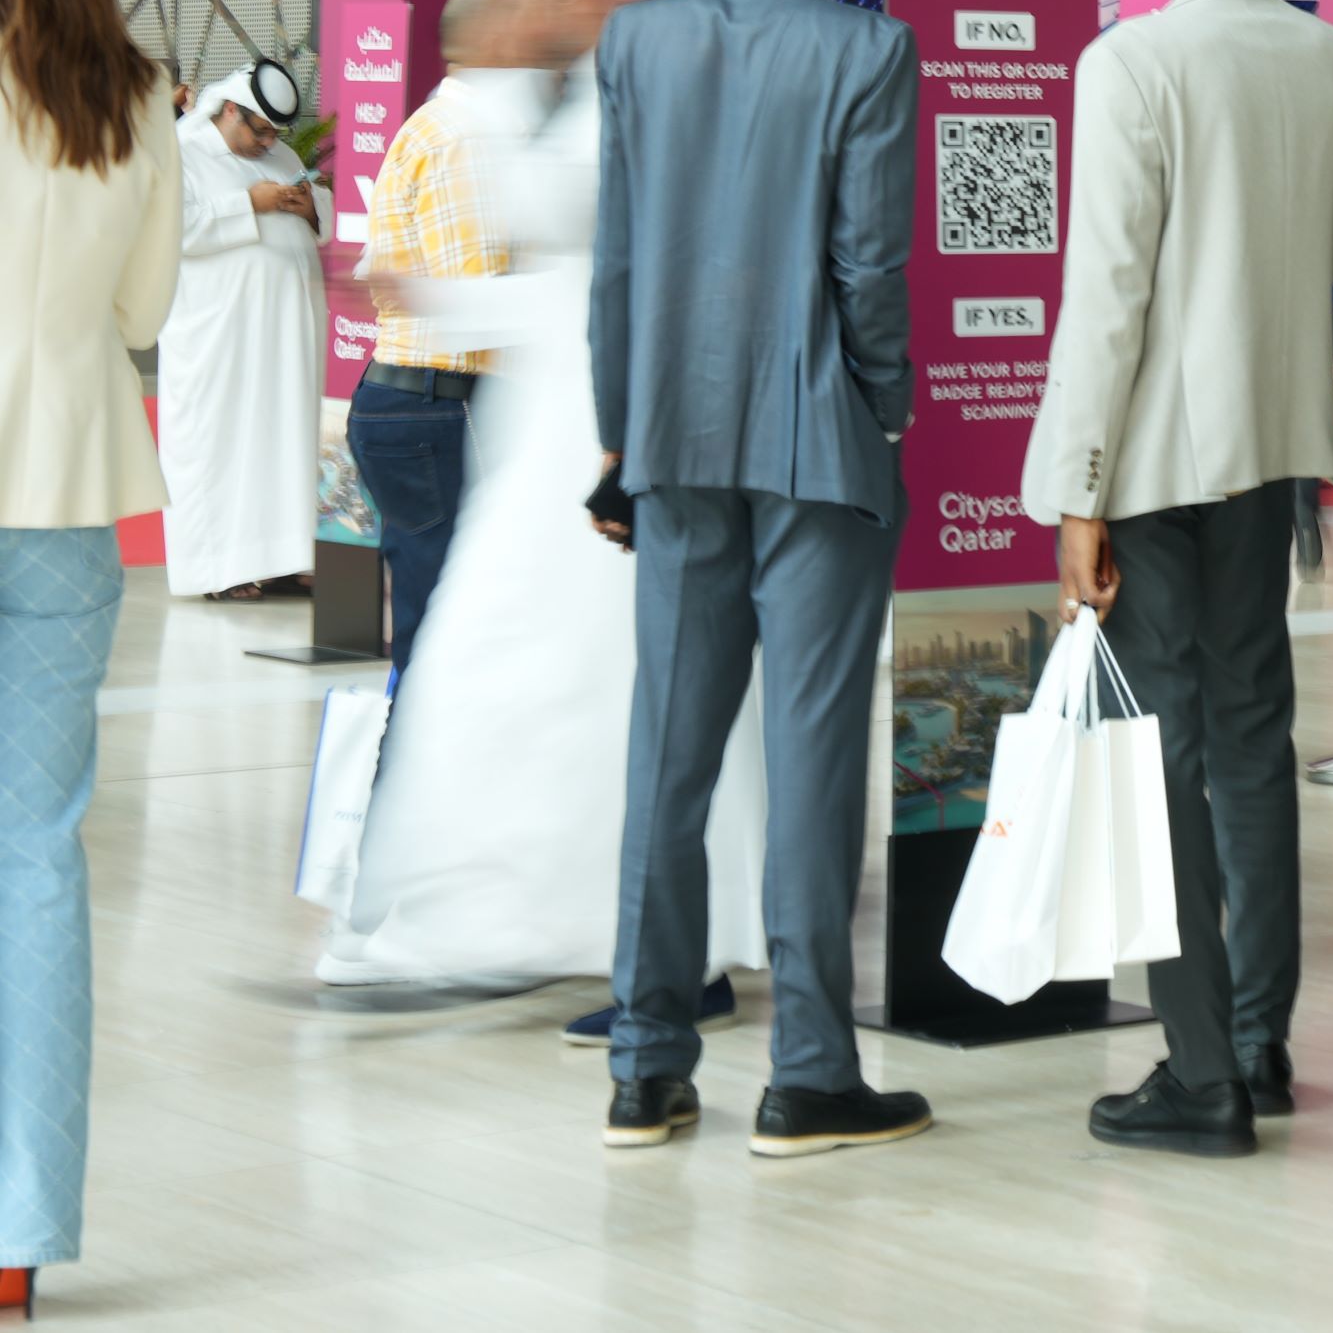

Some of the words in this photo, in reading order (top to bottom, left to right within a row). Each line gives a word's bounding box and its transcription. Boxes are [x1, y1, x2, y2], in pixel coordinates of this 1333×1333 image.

[965, 20, 984, 41] IF
[989, 21, 1026, 45] NO,
[921, 60, 965, 78] SCAN
[964, 61, 1002, 79] THIS
[1002, 62, 1026, 79] QR
[1026, 63, 1069, 80] CODE
[947, 82, 971, 99] TO
[972, 82, 1044, 100] REGISTER
[354, 102, 388, 124] HELP
[352, 131, 386, 154] DESK
[964, 306, 984, 328] IF
[988, 306, 1034, 329] YES,
[333, 337, 367, 360] Qatar
[926, 362, 969, 379] HAVE
[968, 362, 1011, 378] YOUR
[930, 383, 983, 401] BADGE
[985, 381, 1034, 399] READY
[960, 401, 1040, 421] SCANNING
[938, 524, 1016, 553] Qatar
